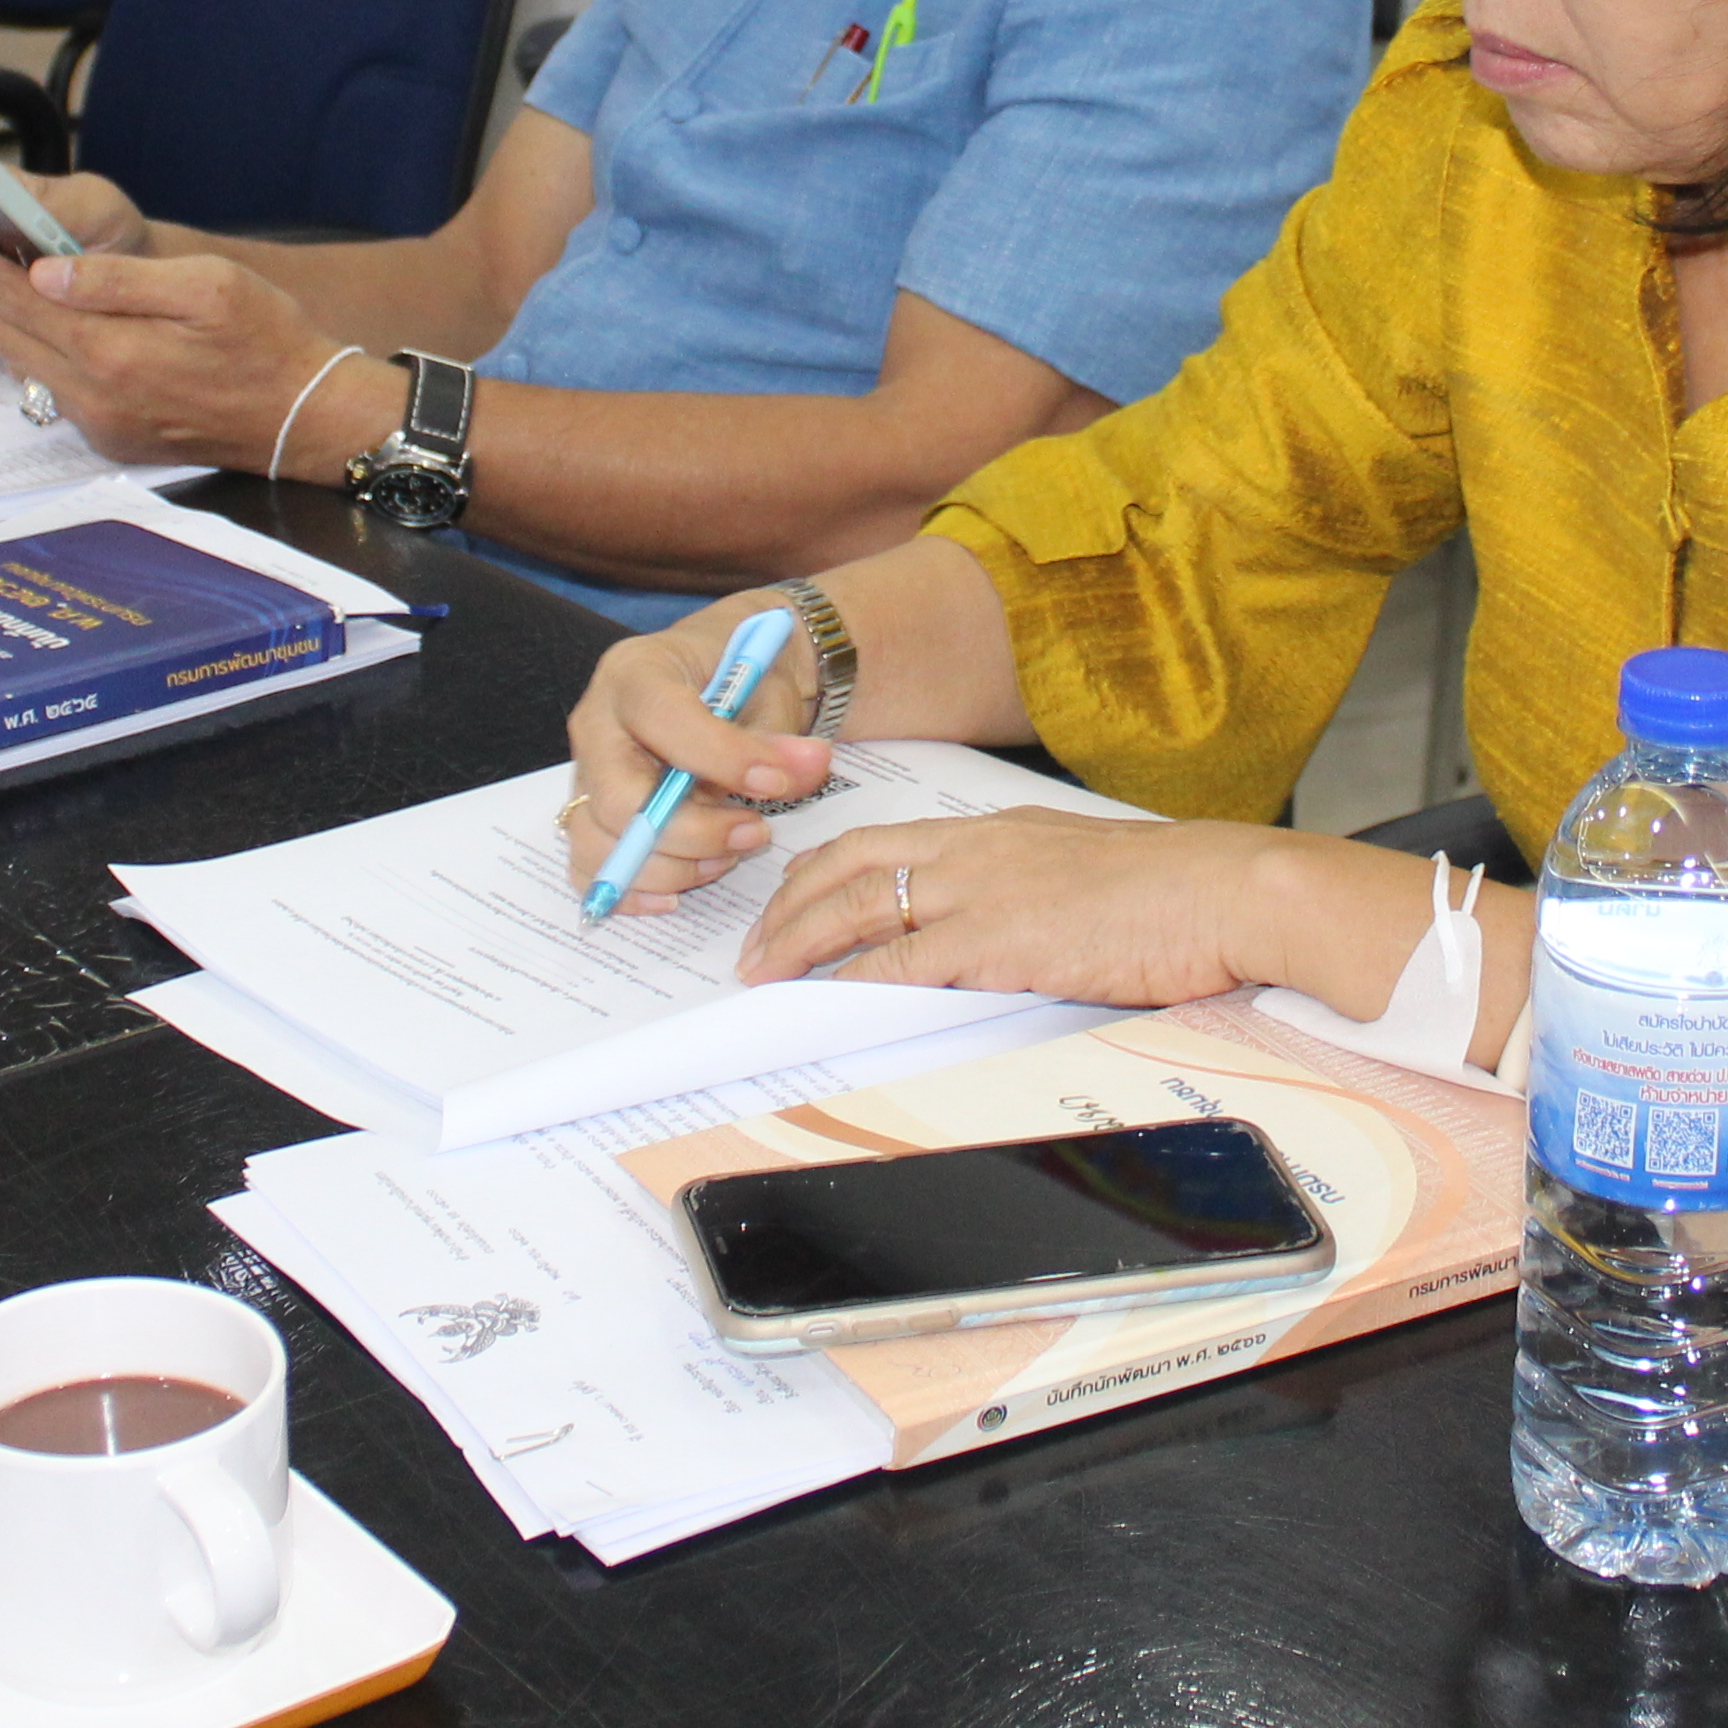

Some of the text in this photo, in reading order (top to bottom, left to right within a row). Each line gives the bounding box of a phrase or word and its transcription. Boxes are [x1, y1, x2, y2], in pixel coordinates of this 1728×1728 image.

[165, 636, 321, 690] กรมการพัฒนาชุมชน
[3, 711, 39, 732] พ.ศ.
[1640, 1086, 1728, 1105] ห้ามจำหน่าย
[1409, 1254, 1519, 1299] กรมการพัฒนา
[1046, 1332, 1267, 1407] บันทึกนักพัฒนา พ.ศ. ๒๕๖๖
